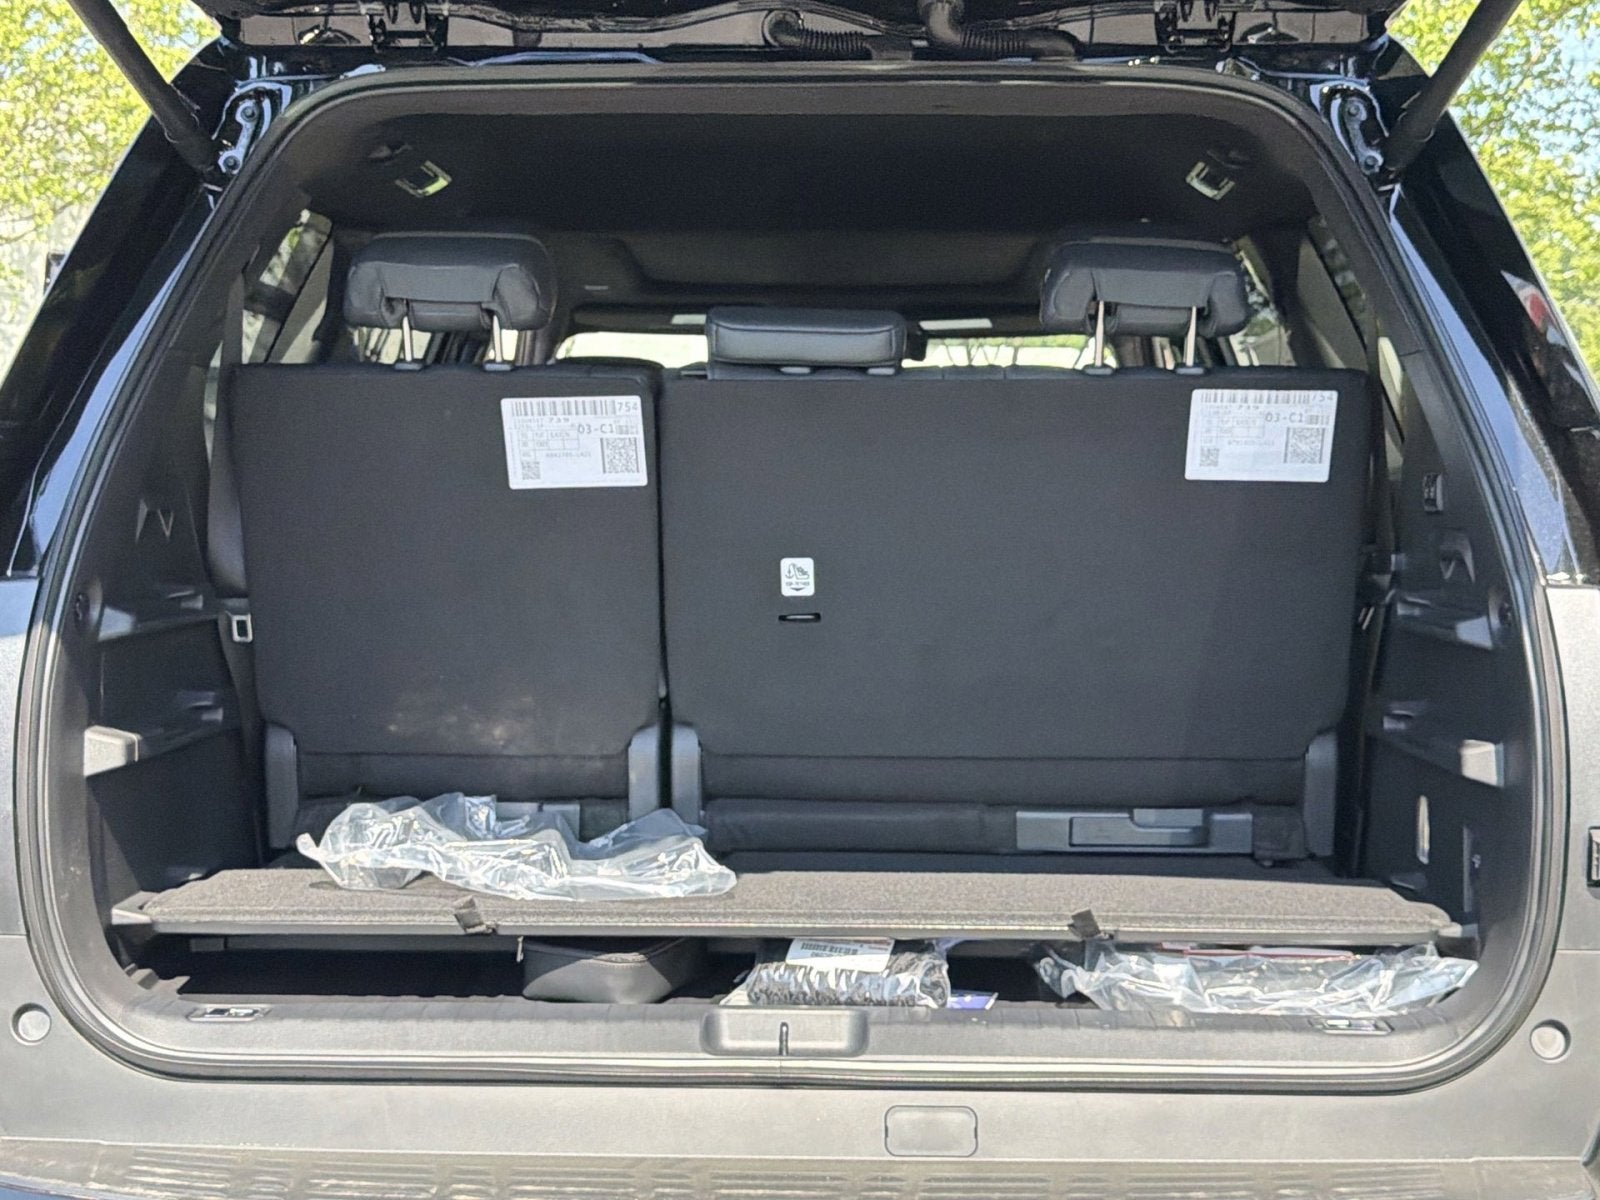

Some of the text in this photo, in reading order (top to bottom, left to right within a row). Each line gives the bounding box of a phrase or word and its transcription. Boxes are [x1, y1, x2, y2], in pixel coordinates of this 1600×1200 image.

[617, 401, 639, 413] 754
[1264, 412, 1304, 423] 03-C1
[577, 422, 615, 435] 03-C1
